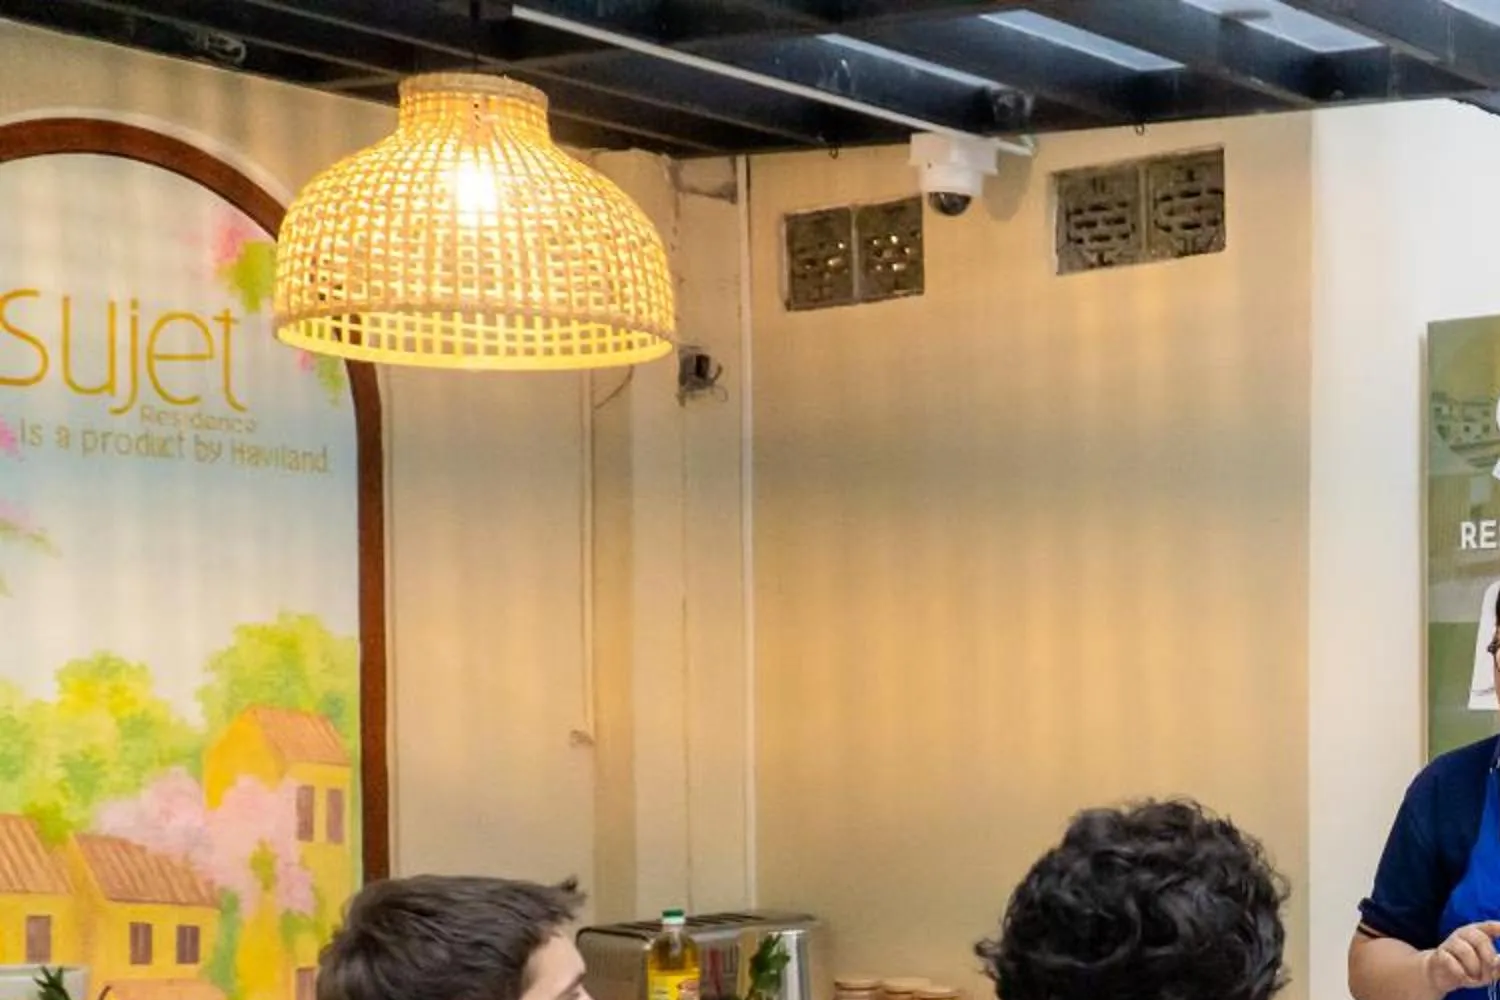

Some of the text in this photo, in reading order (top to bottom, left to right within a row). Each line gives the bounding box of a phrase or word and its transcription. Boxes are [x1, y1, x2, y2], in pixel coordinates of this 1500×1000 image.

[55, 424, 71, 450] a
[82, 428, 185, 460] product
[194, 434, 222, 464] by
